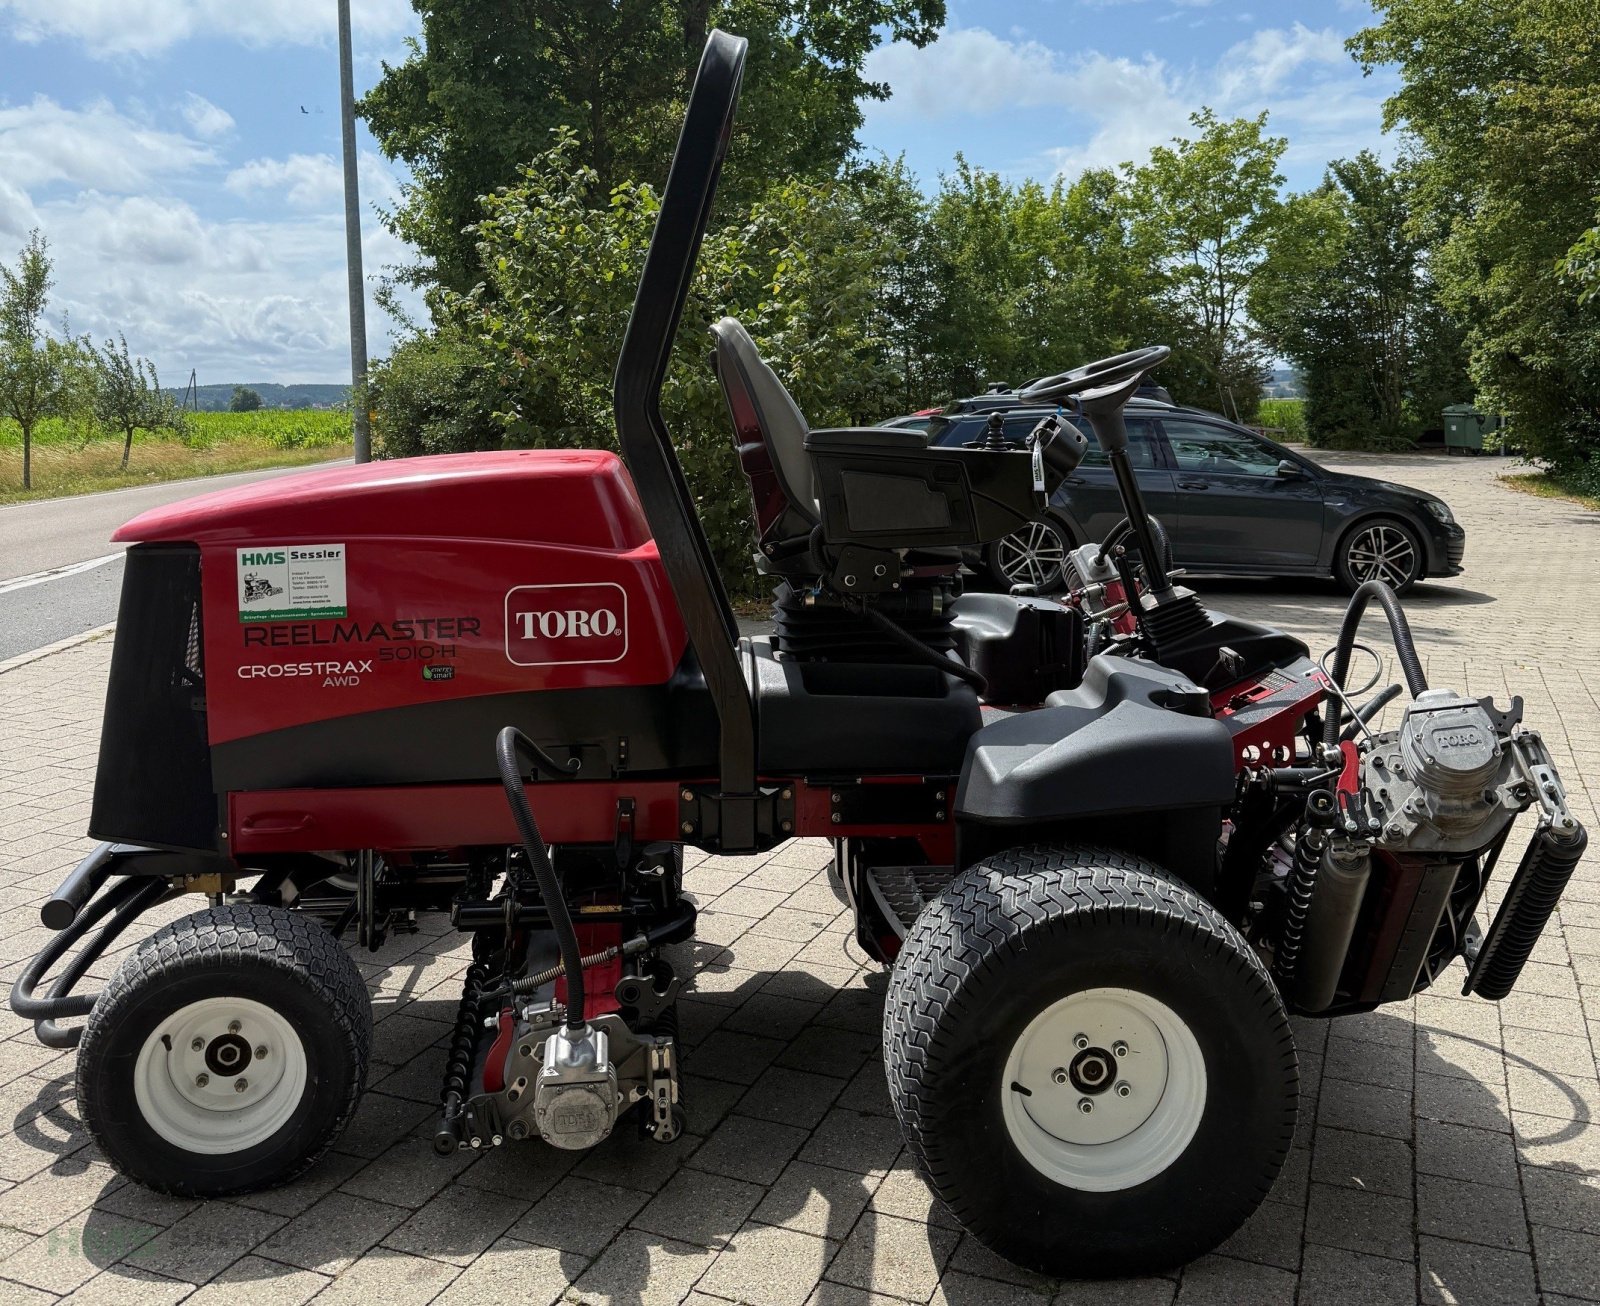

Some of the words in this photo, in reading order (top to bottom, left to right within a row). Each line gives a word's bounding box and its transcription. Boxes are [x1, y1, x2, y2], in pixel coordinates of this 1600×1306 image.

[242, 552, 286, 566] HMS
[291, 550, 341, 560] Sessler
[244, 617, 481, 648] REELMASTER
[515, 608, 617, 640] TORO
[237, 659, 373, 679] CROSSTRAX
[322, 675, 360, 688] AWD
[1437, 733, 1480, 748] TORO
